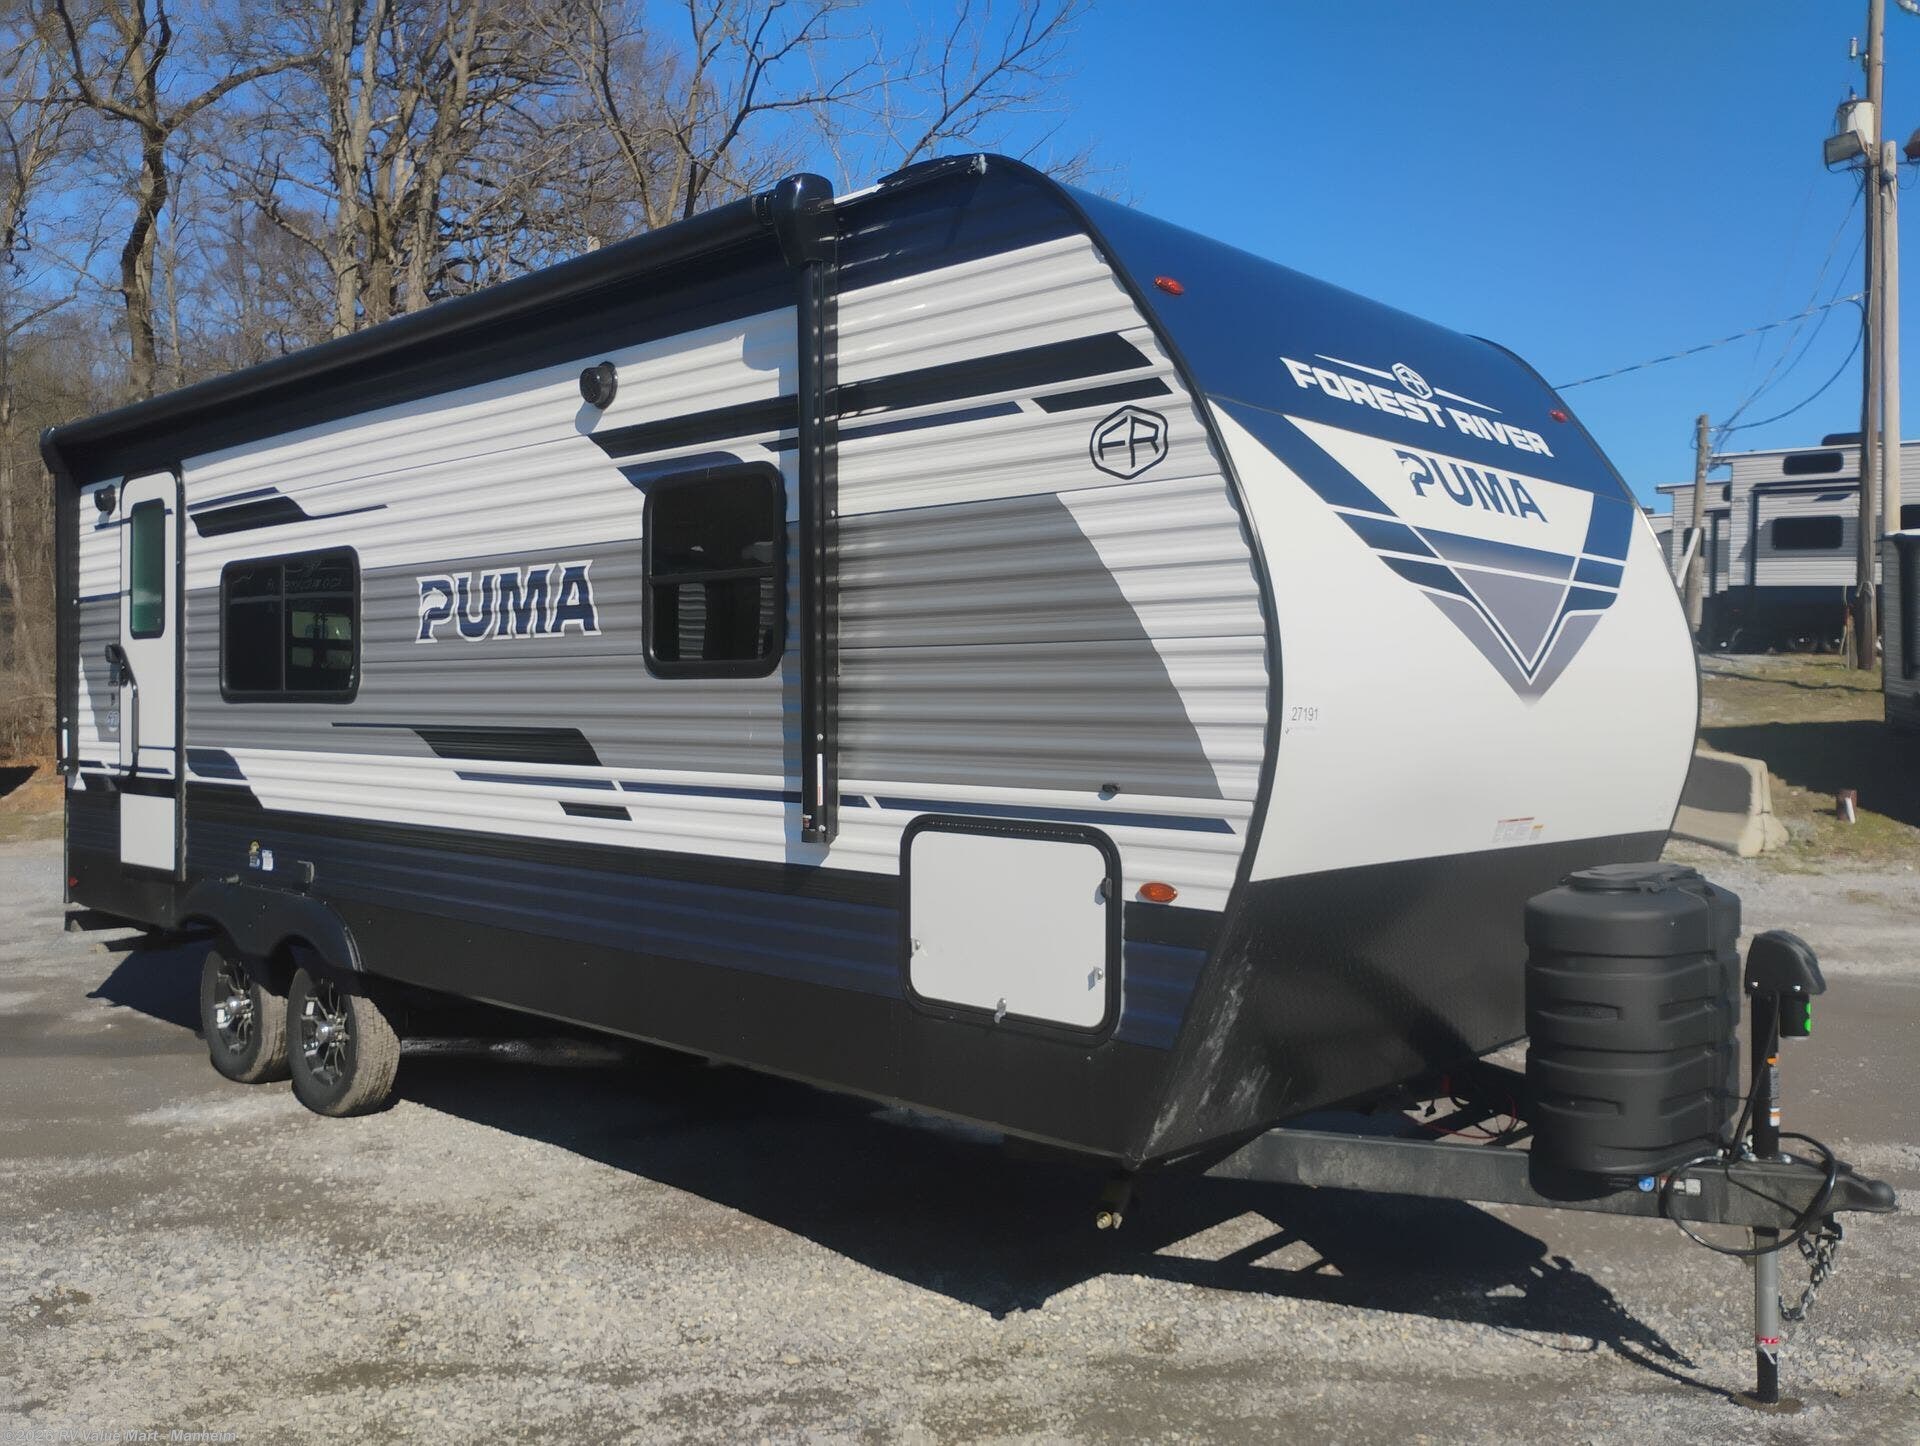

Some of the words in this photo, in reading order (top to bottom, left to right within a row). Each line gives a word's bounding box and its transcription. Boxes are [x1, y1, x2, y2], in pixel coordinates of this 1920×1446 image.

[1280, 357, 1447, 428] FOREST
[1446, 408, 1554, 457] RIVER
[1392, 449, 1549, 523] PUMA
[415, 560, 602, 644] PUMA
[1291, 706, 1318, 721] 27191
